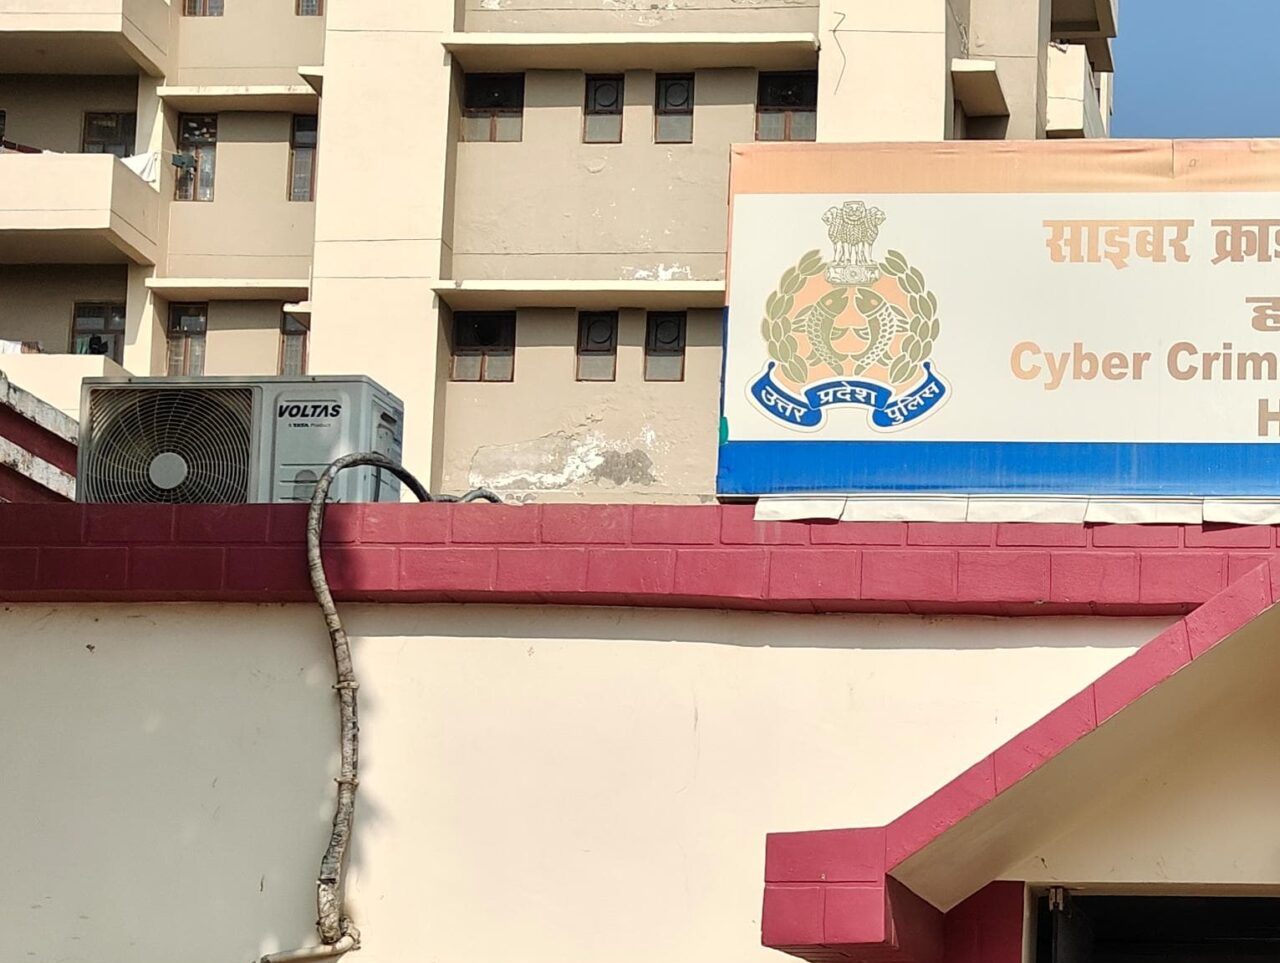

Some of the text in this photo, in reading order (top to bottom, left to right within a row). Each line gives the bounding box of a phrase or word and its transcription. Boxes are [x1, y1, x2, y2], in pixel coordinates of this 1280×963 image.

[1043, 218, 1195, 270] साइबर
[1010, 341, 1151, 390] Cyber
[278, 404, 342, 418] VOLTAS
[761, 381, 940, 425] उत्तर प्रदेश पुलिस
